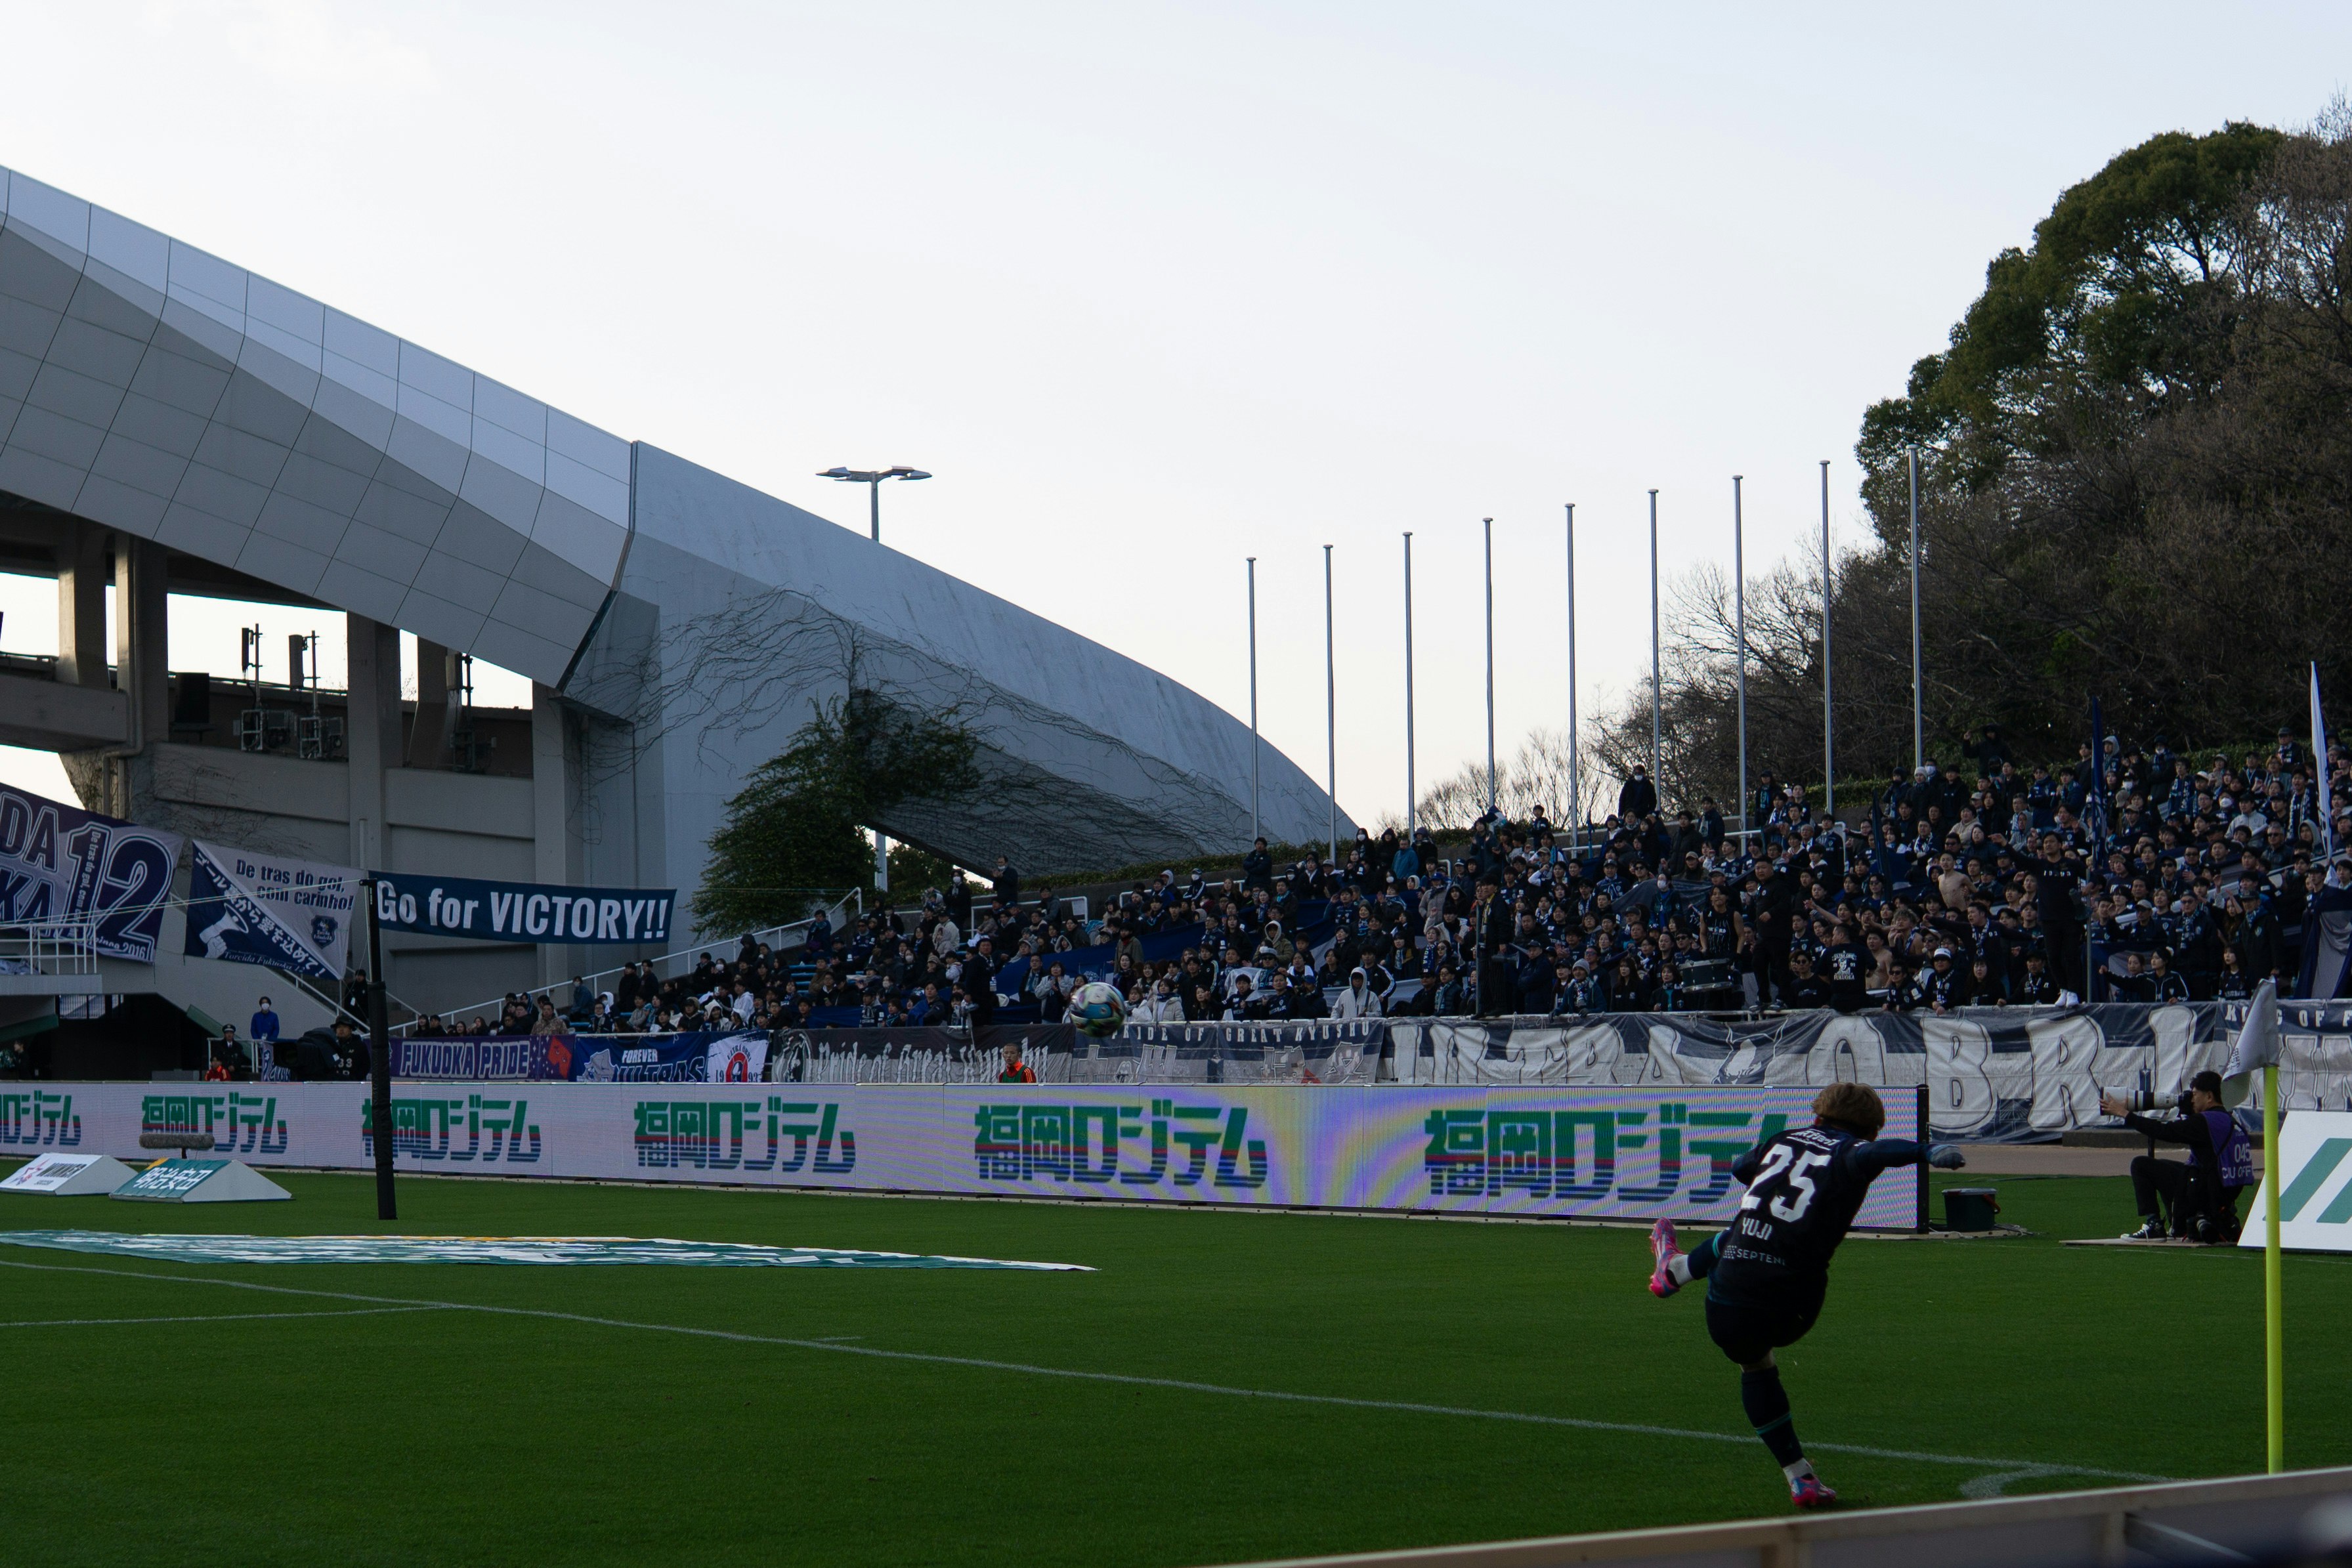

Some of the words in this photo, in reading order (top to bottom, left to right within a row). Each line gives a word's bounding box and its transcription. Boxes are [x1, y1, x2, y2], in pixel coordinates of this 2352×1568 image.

[91, 830, 102, 843] De
[88, 843, 98, 861] tras
[85, 862, 95, 873] do
[236, 858, 255, 878] De
[261, 866, 291, 885] tras
[295, 870, 314, 886] do
[317, 876, 345, 893] gol,
[67, 820, 173, 962] 12
[256, 885, 289, 902] com
[293, 891, 354, 910] carinho!
[377, 879, 417, 925] Go
[428, 887, 479, 930] for
[490, 891, 668, 940] VICTORY!!
[122, 941, 146, 960] 2016
[2299, 1009, 2325, 1028] OF
[1185, 1027, 1204, 1042] OF
[1226, 1027, 1283, 1043] GREAT
[1294, 1021, 1369, 1042] KYUSHU
[399, 1041, 475, 1078] FUKUOKA
[478, 1040, 530, 1078] PRIDE
[622, 1048, 658, 1063] FOREVER
[716, 1070, 724, 1082] 19
[633, 1096, 856, 1173] 福岡ロジテム
[974, 1099, 1268, 1189] 福岡ロジテム
[1424, 1103, 1787, 1204] 福岡ロジテ
[2234, 1142, 2252, 1162] 045
[133, 1167, 214, 1190] 明治安田
[1740, 1143, 1832, 1223] 25
[1742, 1217, 1774, 1240] YUJI
